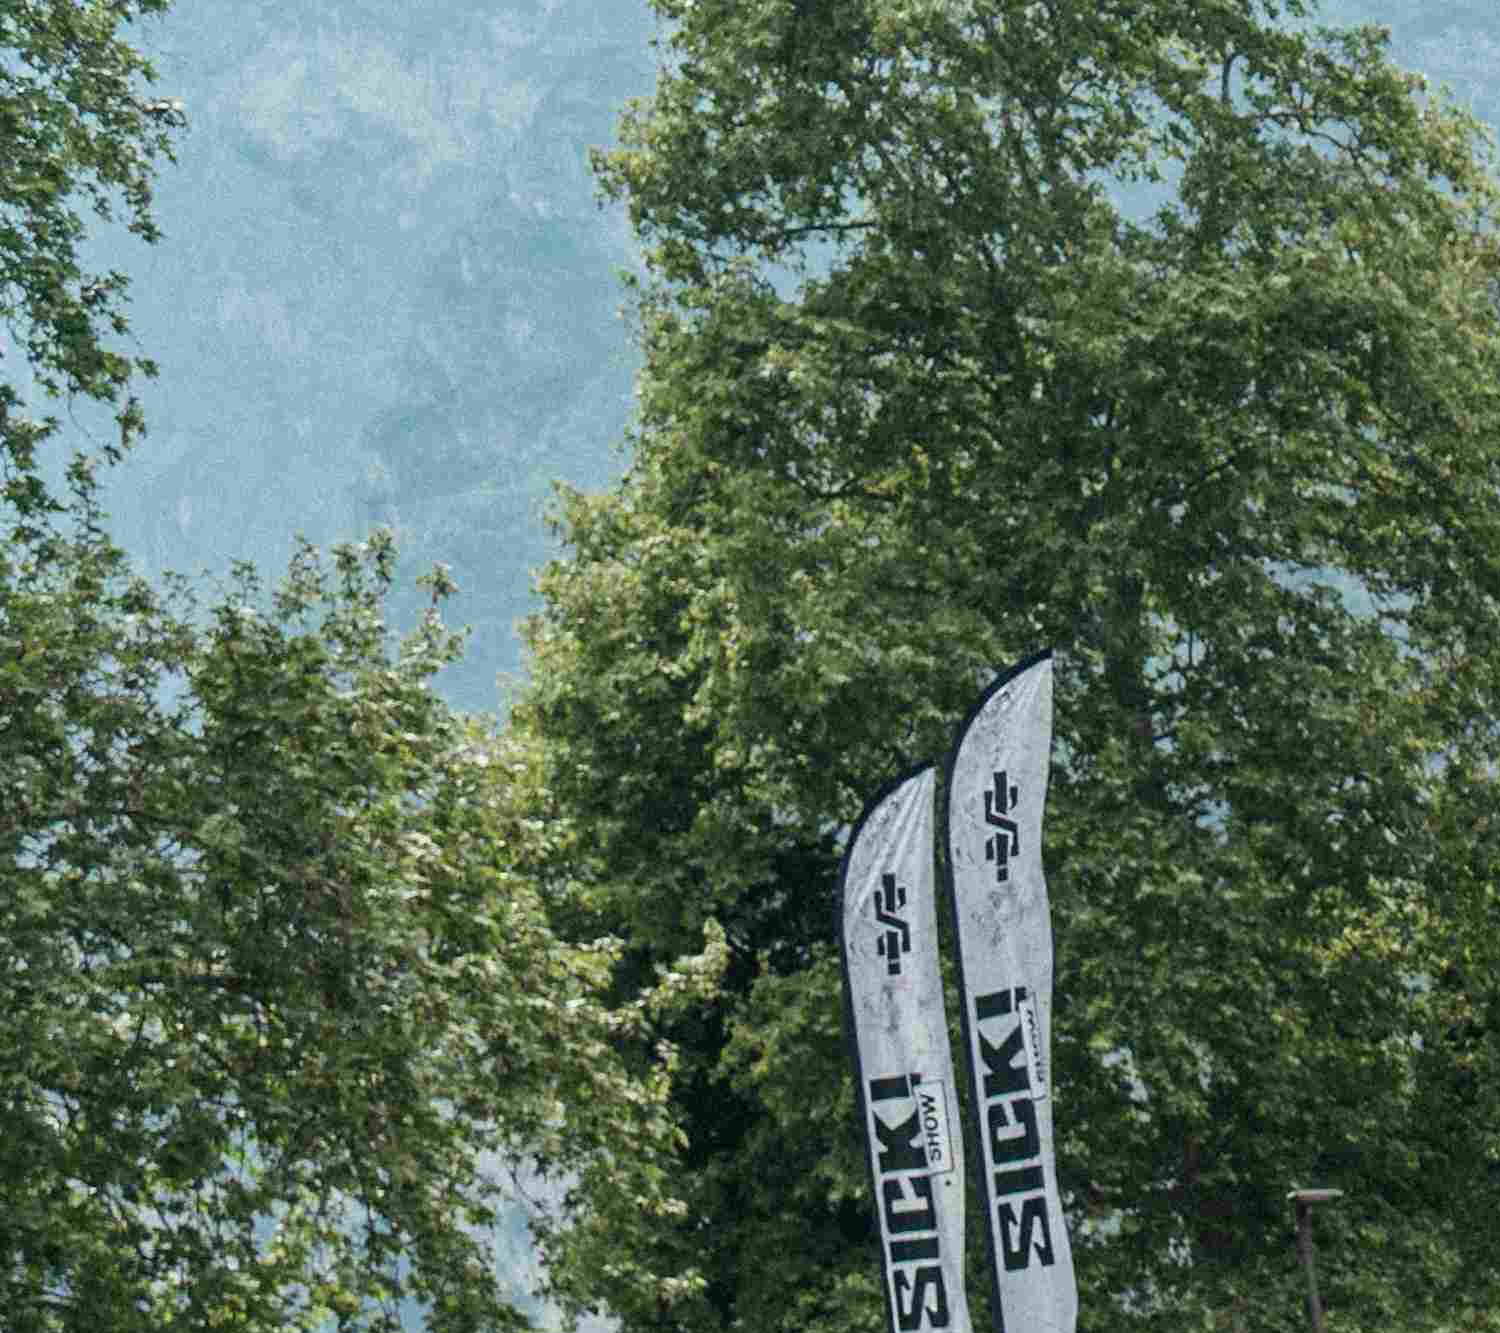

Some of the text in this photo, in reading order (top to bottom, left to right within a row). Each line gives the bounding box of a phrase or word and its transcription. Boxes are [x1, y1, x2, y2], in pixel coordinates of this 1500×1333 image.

[869, 1072, 950, 1332] SICK!
[920, 1093, 943, 1162] SHOW
[975, 986, 1056, 1271] SICK!
